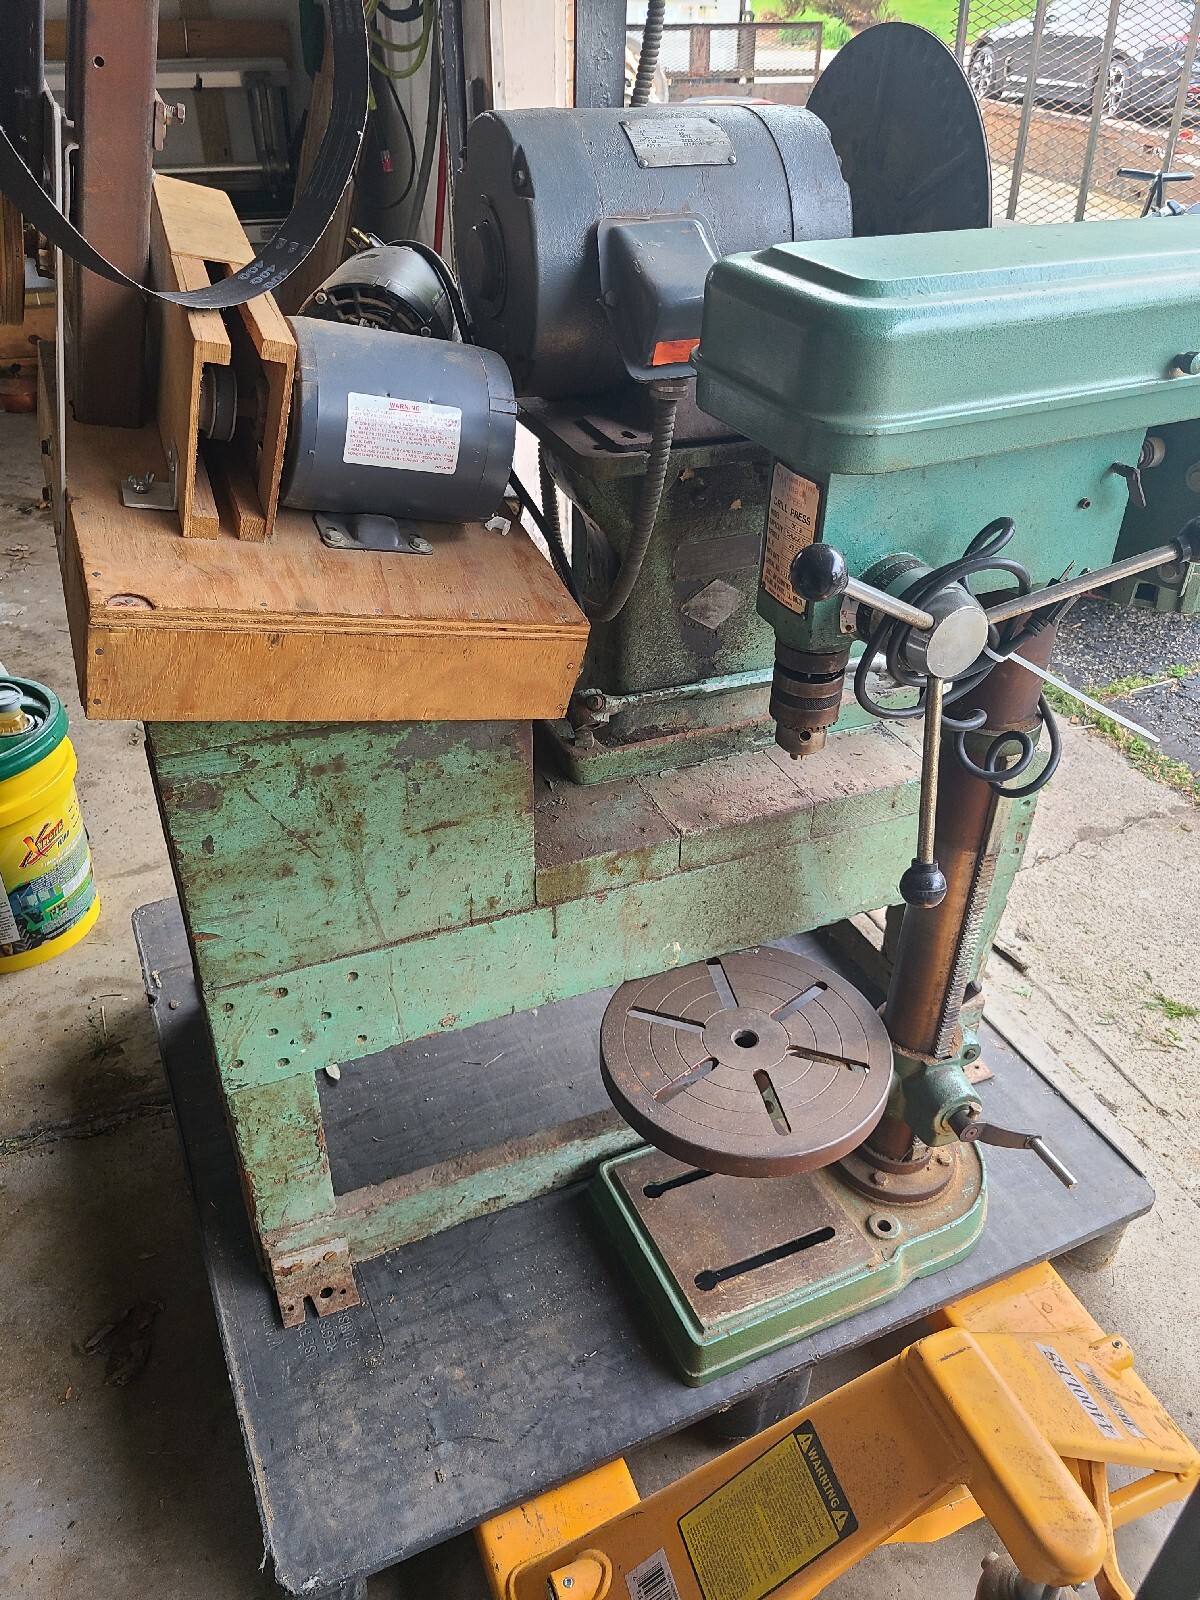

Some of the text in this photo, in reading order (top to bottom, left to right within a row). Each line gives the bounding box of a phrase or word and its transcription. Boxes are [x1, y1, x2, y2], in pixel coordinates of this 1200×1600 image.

[388, 401, 421, 412] WARNING
[790, 507, 811, 526] PRESS
[302, 1338, 320, 1361] USE
[318, 1318, 339, 1353] REGIST
[1042, 1350, 1117, 1435] 4400LBS
[808, 1445, 840, 1509] WARNING
